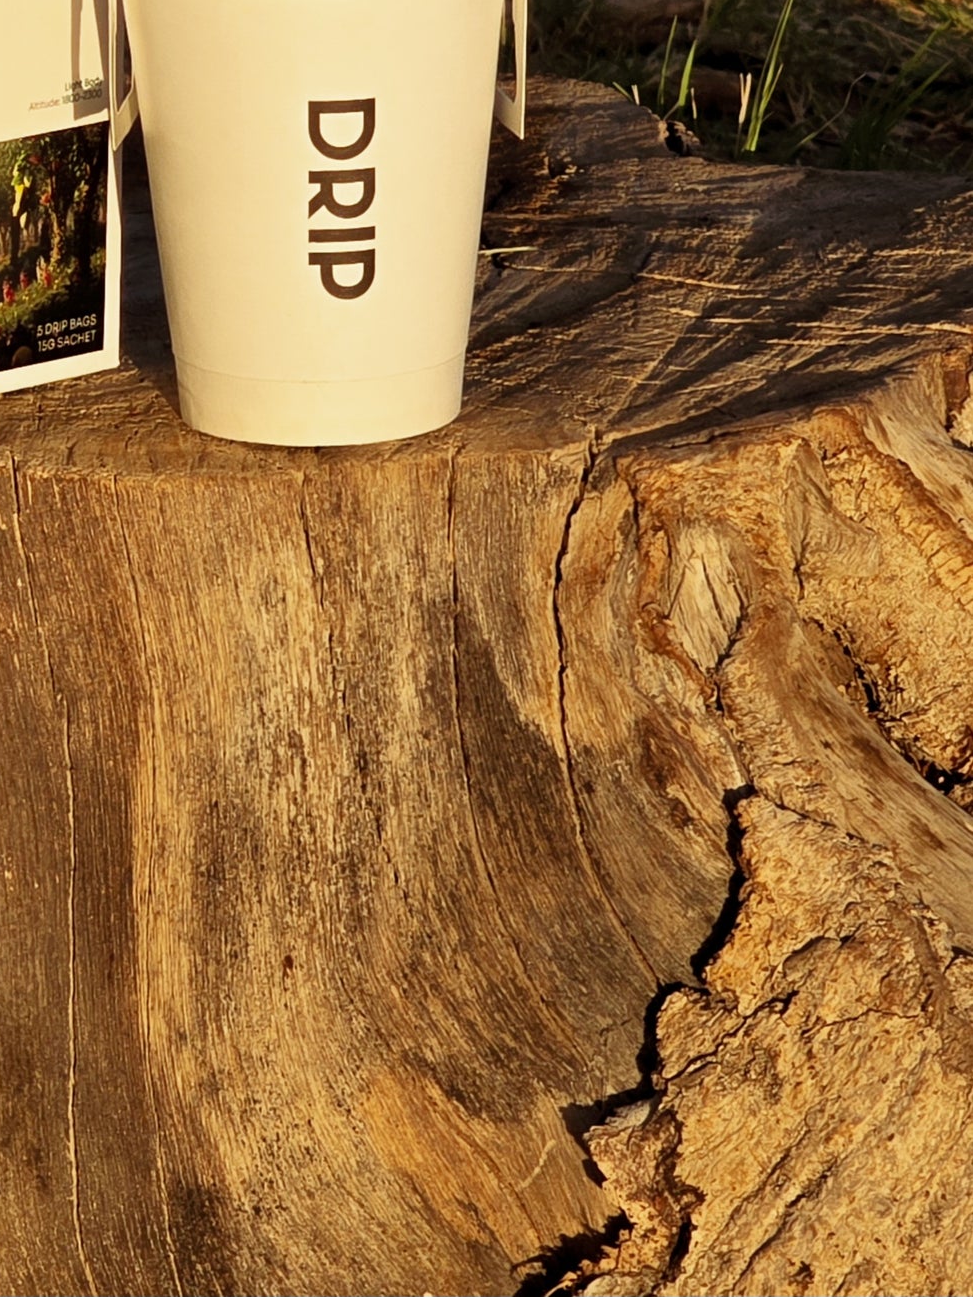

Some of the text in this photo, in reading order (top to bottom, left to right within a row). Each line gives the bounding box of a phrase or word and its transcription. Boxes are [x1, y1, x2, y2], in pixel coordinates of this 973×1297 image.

[308, 97, 376, 300] DRIP
[37, 314, 97, 337] 5 DRIP BAGS
[38, 329, 96, 352] 15G SACHET
